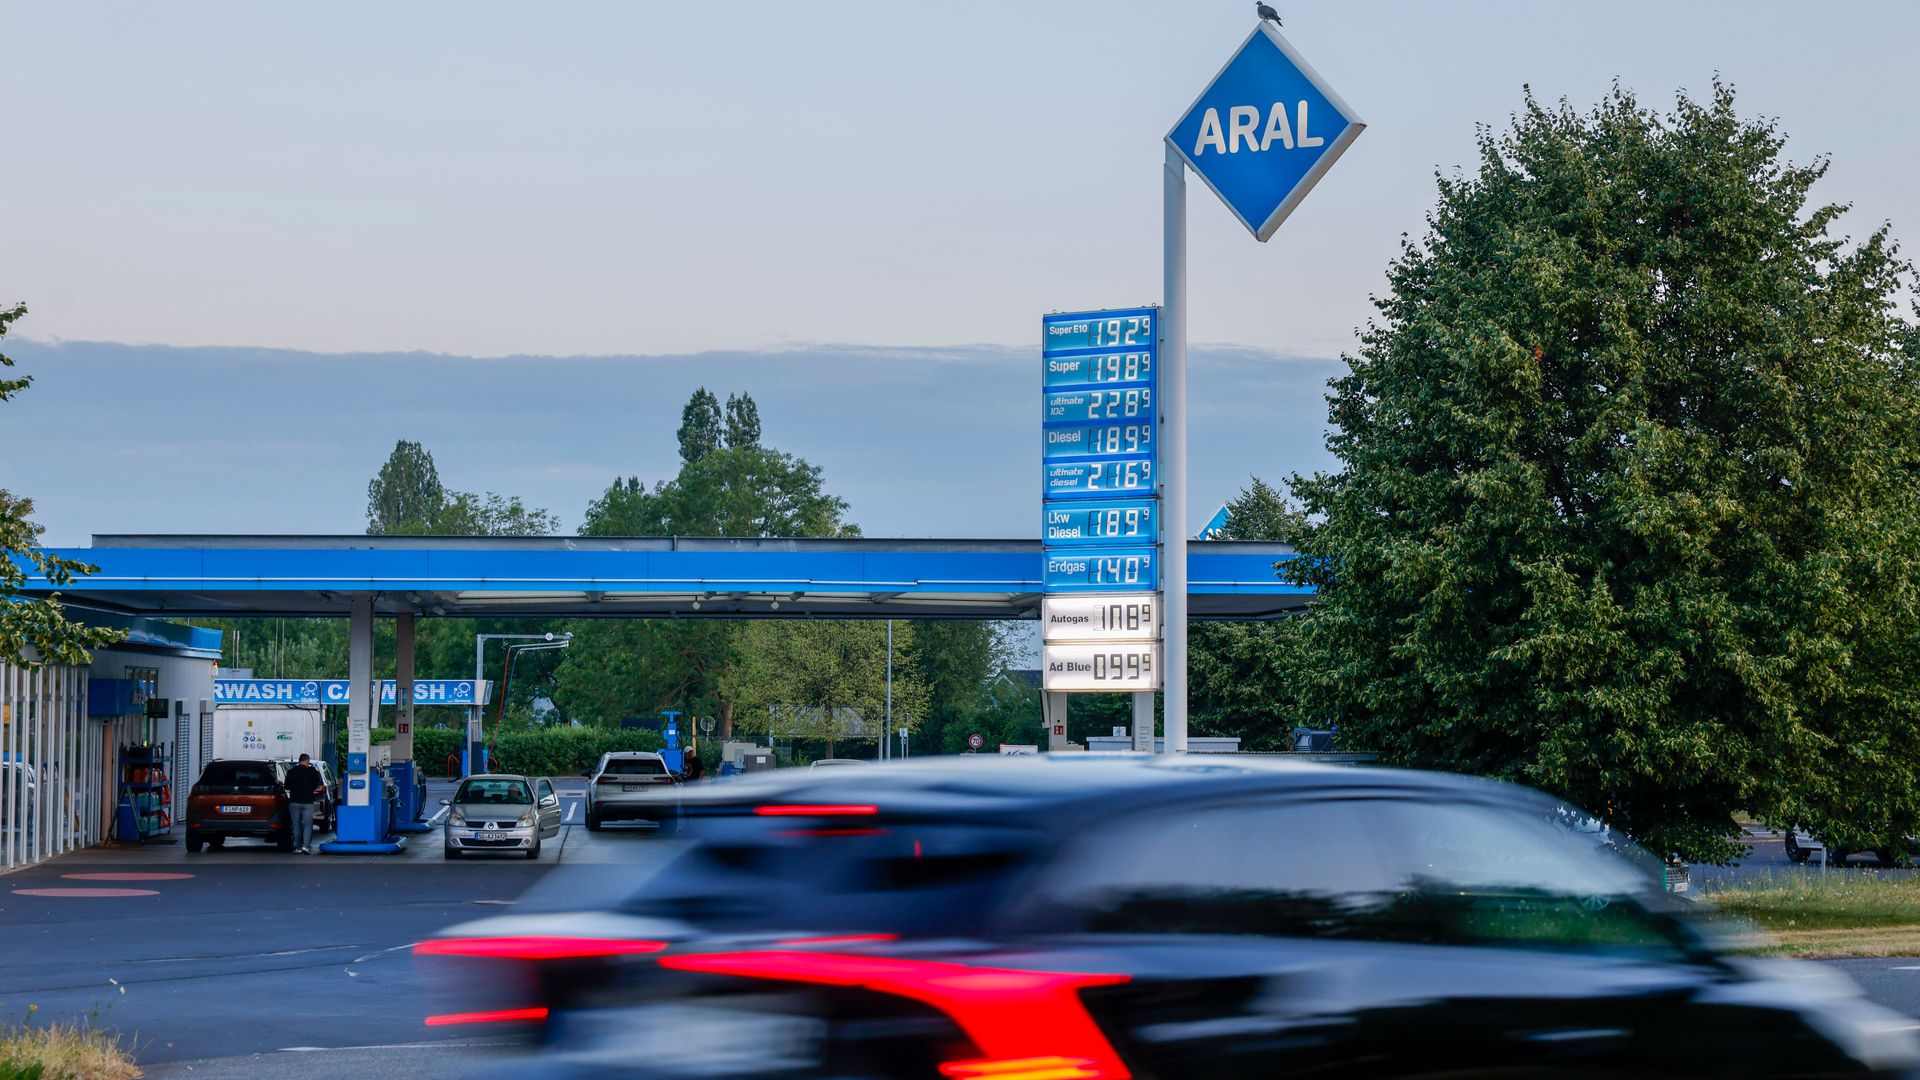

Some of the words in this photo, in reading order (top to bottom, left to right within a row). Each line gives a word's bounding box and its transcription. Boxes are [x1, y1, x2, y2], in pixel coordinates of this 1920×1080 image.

[1194, 100, 1324, 156] ARAL
[1049, 326, 1072, 336] Super
[1073, 324, 1088, 333] E10
[1049, 361, 1080, 374] Super
[1050, 396, 1084, 406] ultimate
[1050, 407, 1065, 416] 102
[1048, 430, 1081, 443] Diesel
[1050, 468, 1083, 477] ultimate
[1050, 478, 1078, 487] diesel
[1048, 511, 1070, 524] Lkw
[1048, 526, 1081, 538] Diesel
[1048, 561, 1086, 574] Erdgas
[1050, 614, 1089, 624] Autogas
[1049, 662, 1063, 671] Ad
[1067, 662, 1091, 672] Blue
